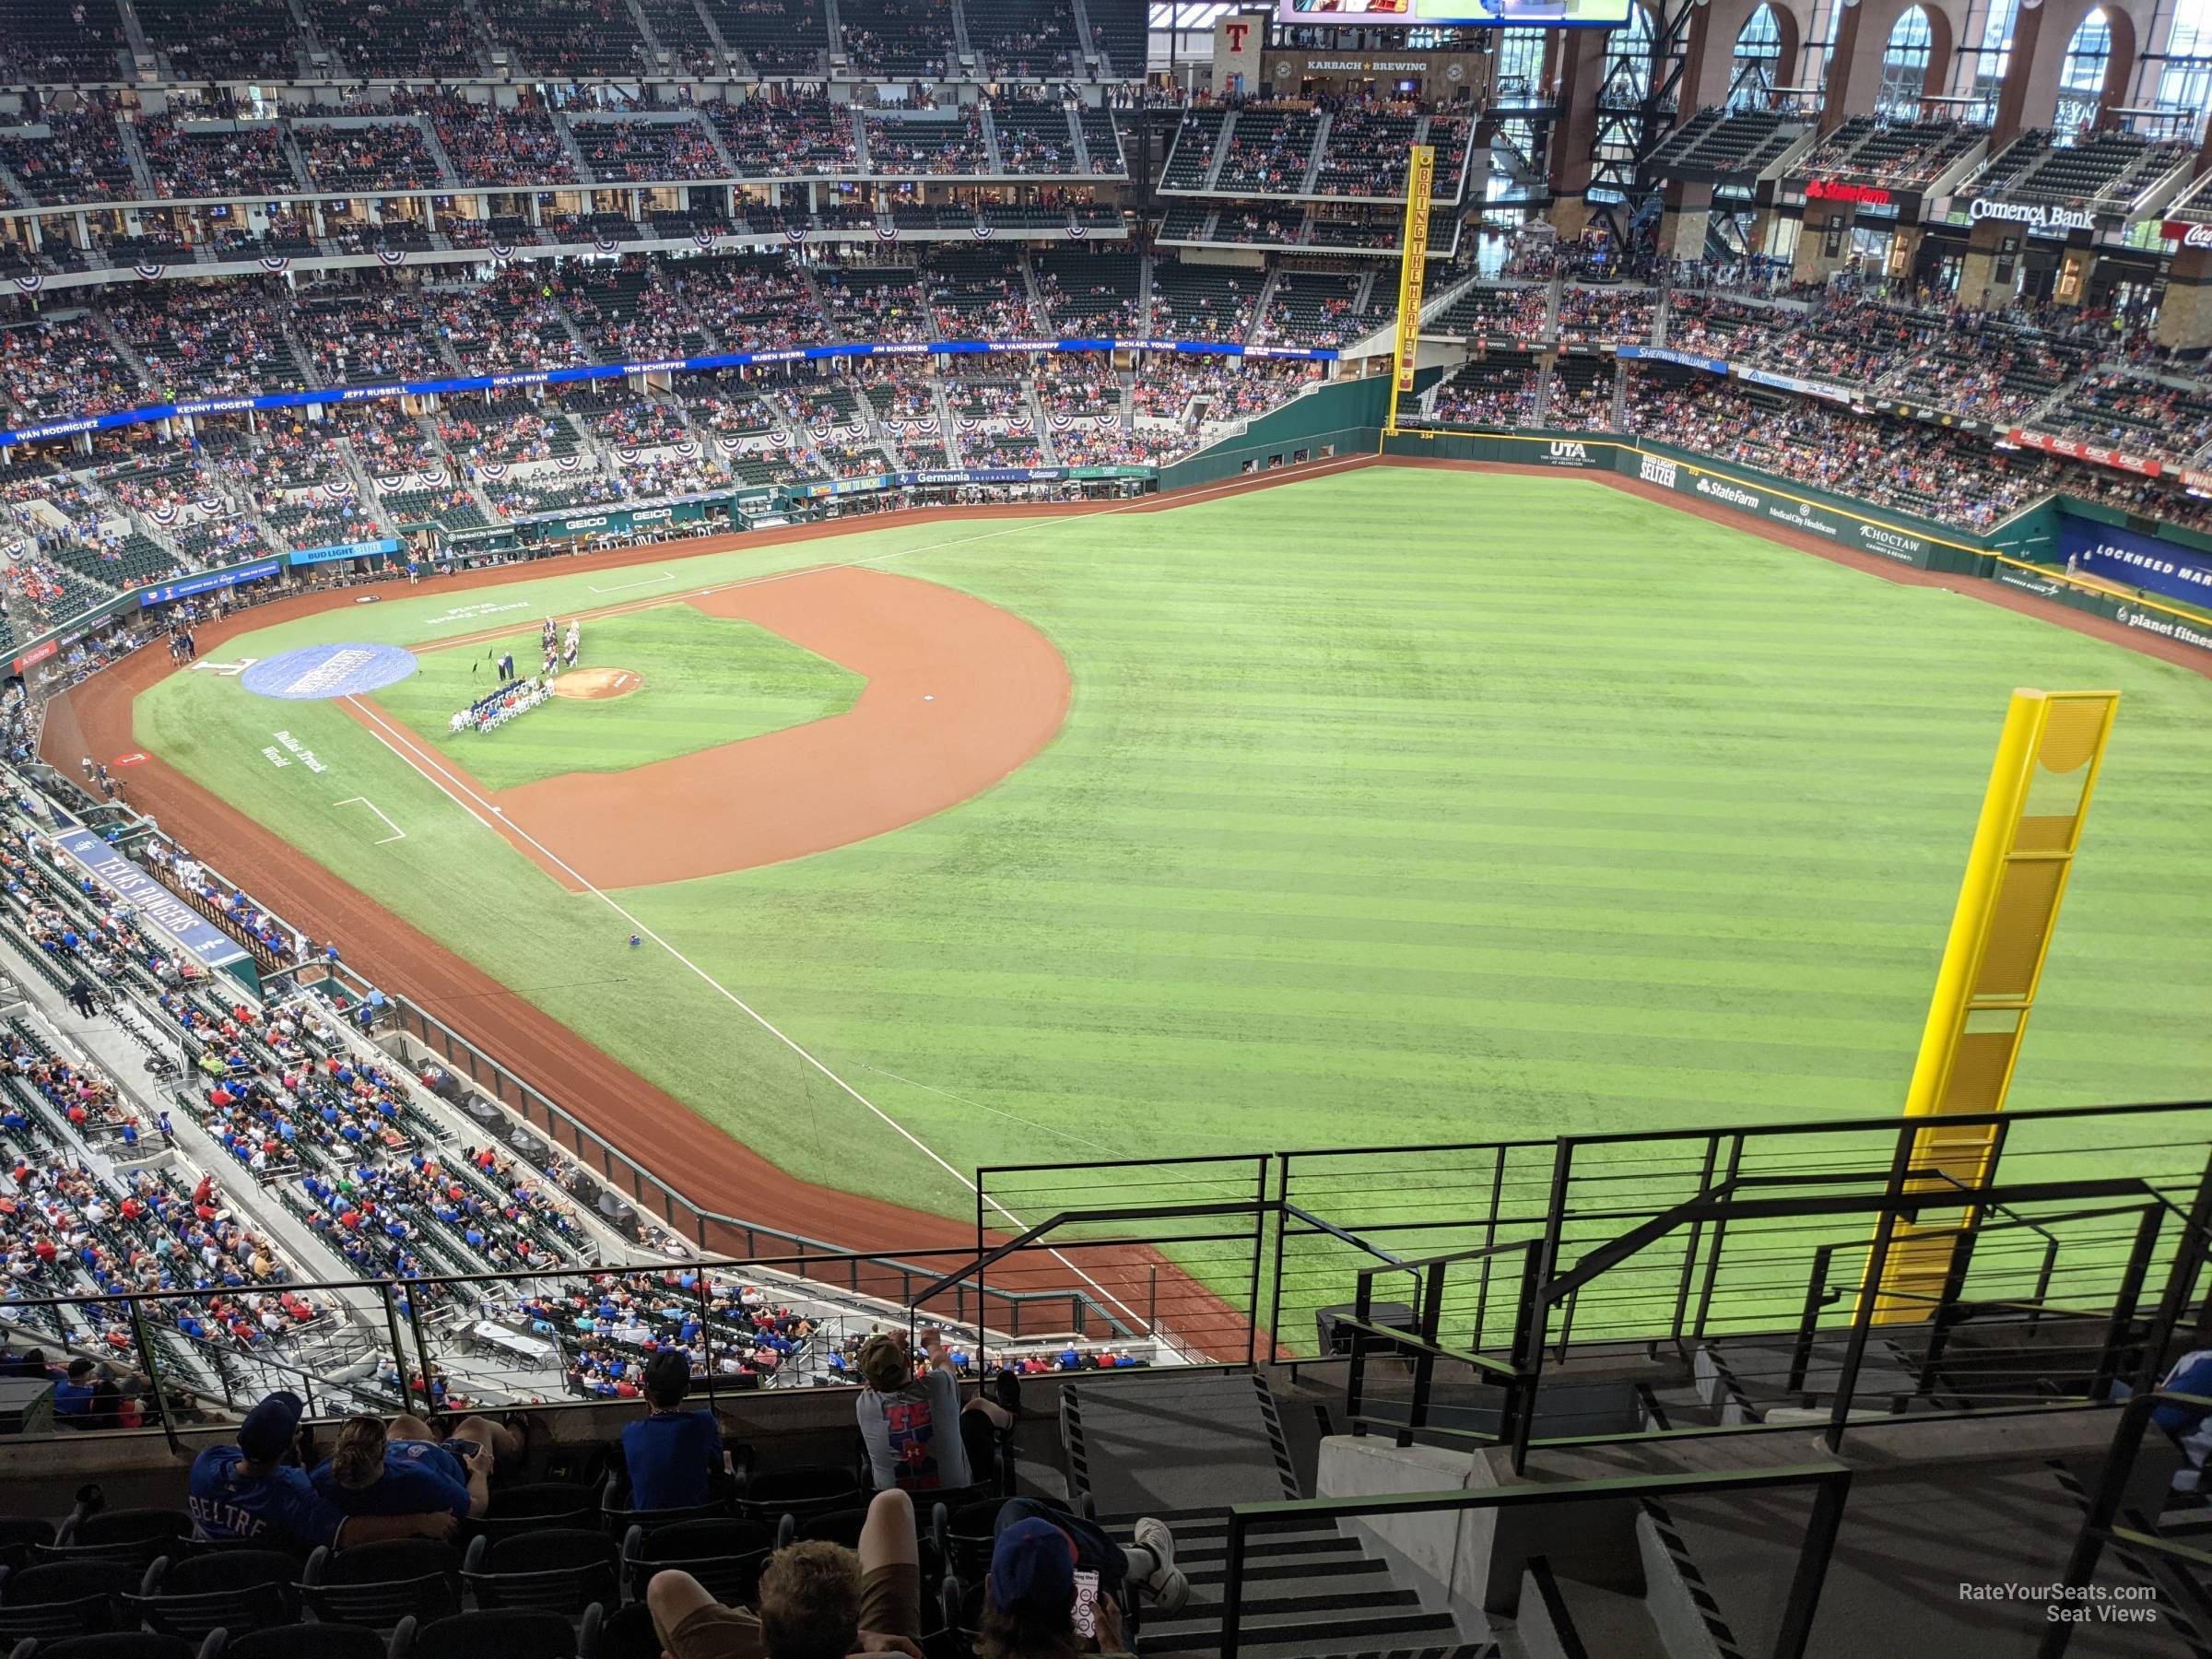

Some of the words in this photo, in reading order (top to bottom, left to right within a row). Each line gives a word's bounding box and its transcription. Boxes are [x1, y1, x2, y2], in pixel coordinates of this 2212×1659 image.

[1227, 24, 1249, 53] T
[1307, 61, 1361, 70] KARBACH
[1372, 62, 1427, 71] BREWING
[1415, 169, 1429, 237] BRING
[2050, 206, 2098, 229] Bank
[1412, 242, 1422, 282] THE
[1406, 286, 1418, 338] HEAT
[780, 351, 806, 359] SIERRA
[623, 365, 641, 373] TOM
[642, 361, 687, 371] SCHIEFFER
[493, 376, 524, 385] NOLAN
[525, 373, 547, 382] RYAN
[342, 390, 365, 399] JEFF
[367, 387, 408, 397] RUSSELL
[176, 403, 211, 414] KENNY
[213, 399, 255, 412] ROGERS
[2019, 431, 2044, 443] DEX
[2053, 439, 2077, 452] DEX
[1550, 441, 1586, 458] UTA
[2085, 446, 2111, 460] DEX
[1642, 453, 1657, 465] BUD
[1656, 458, 1677, 470] LIGHT
[2118, 454, 2147, 468] DEX
[917, 472, 970, 483] Germania
[1640, 461, 1676, 488] SELTZER
[837, 481, 851, 493] HOW
[852, 480, 862, 491] TO
[632, 508, 673, 521] GEICO
[1769, 507, 1792, 523] Medical
[1791, 515, 1804, 526] City
[1804, 518, 1836, 535] Healthcare
[566, 517, 607, 530] GEICO
[456, 532, 476, 541] Medical
[477, 531, 487, 539] City
[487, 527, 514, 537] Healthcare
[1859, 525, 1920, 552] CHOCTAW
[308, 550, 326, 559] BUD
[328, 547, 354, 558] LIGHT
[354, 542, 382, 555] SELTZER
[2095, 544, 2174, 574] LOCKHEED
[2128, 614, 2173, 635] planet
[261, 746, 291, 768] World
[273, 730, 303, 754] Dallas
[296, 749, 328, 773] Truck
[94, 856, 142, 890] TEXAS
[130, 886, 200, 933] RANGERS
